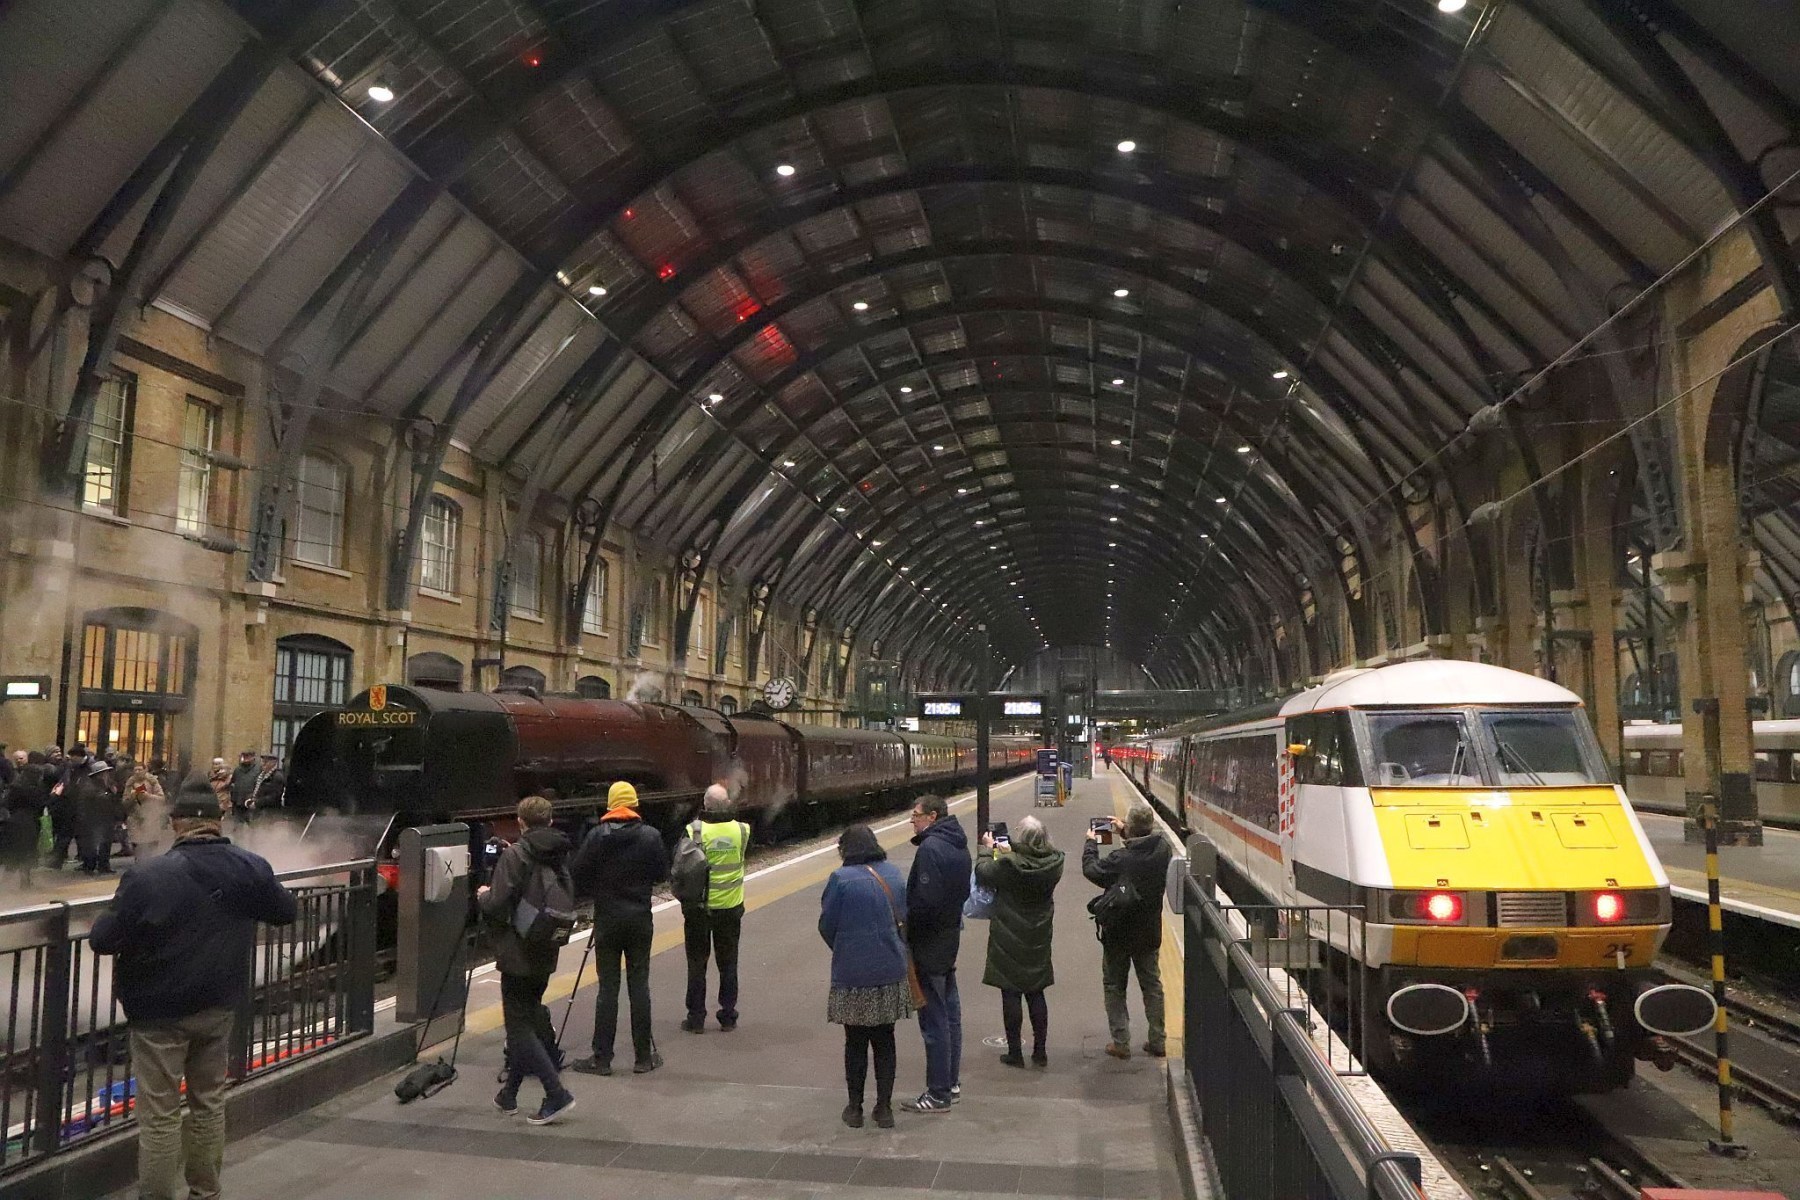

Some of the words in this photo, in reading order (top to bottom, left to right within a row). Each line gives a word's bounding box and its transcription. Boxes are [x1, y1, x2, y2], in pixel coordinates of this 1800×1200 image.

[339, 712, 378, 724] ROYAL
[382, 711, 417, 724] SCOT
[1603, 943, 1633, 959] 25
